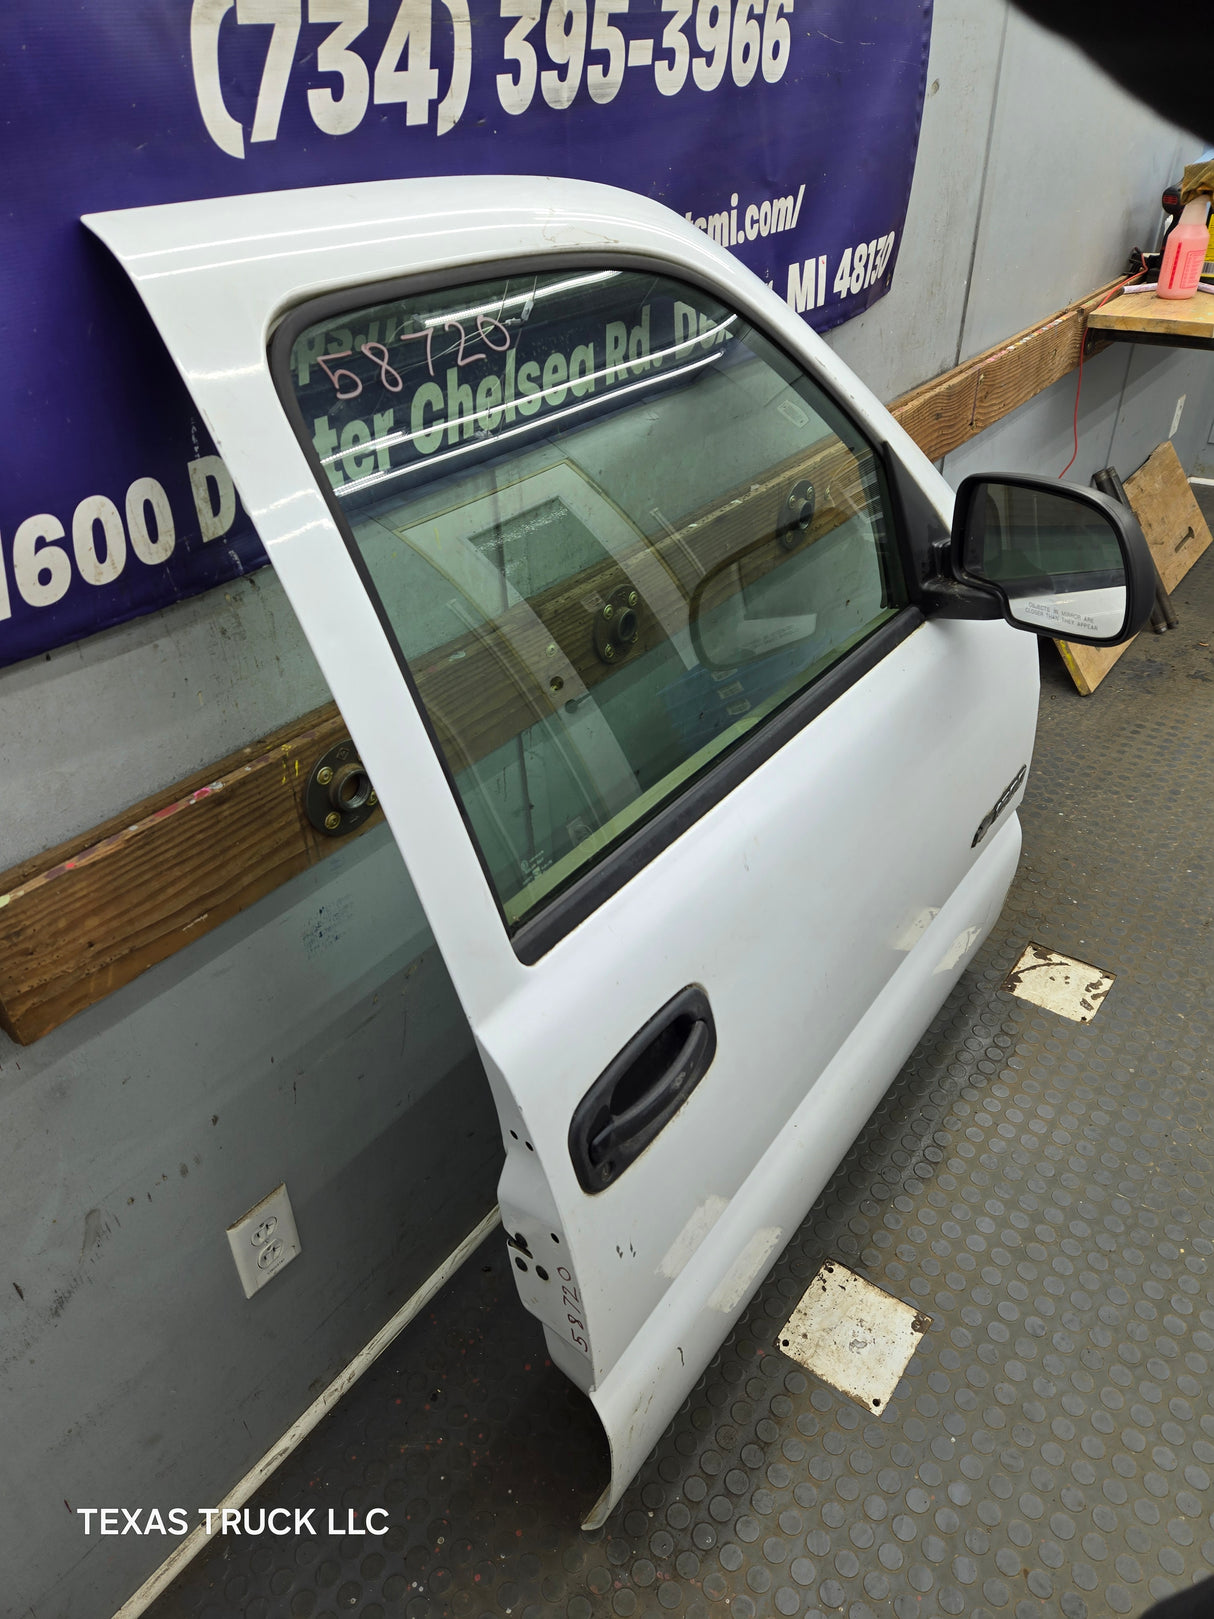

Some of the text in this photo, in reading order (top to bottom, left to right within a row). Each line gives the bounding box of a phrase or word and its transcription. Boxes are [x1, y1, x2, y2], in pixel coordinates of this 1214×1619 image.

[190, 0, 794, 160] (734) 395-3966
[685, 184, 806, 248] mi.com/
[317, 315, 510, 399] 58720
[410, 341, 595, 455] Chelsea
[606, 304, 663, 385] Rd.
[787, 254, 827, 313] MI
[833, 231, 896, 299] 48130
[557, 1266, 588, 1353] 58720
